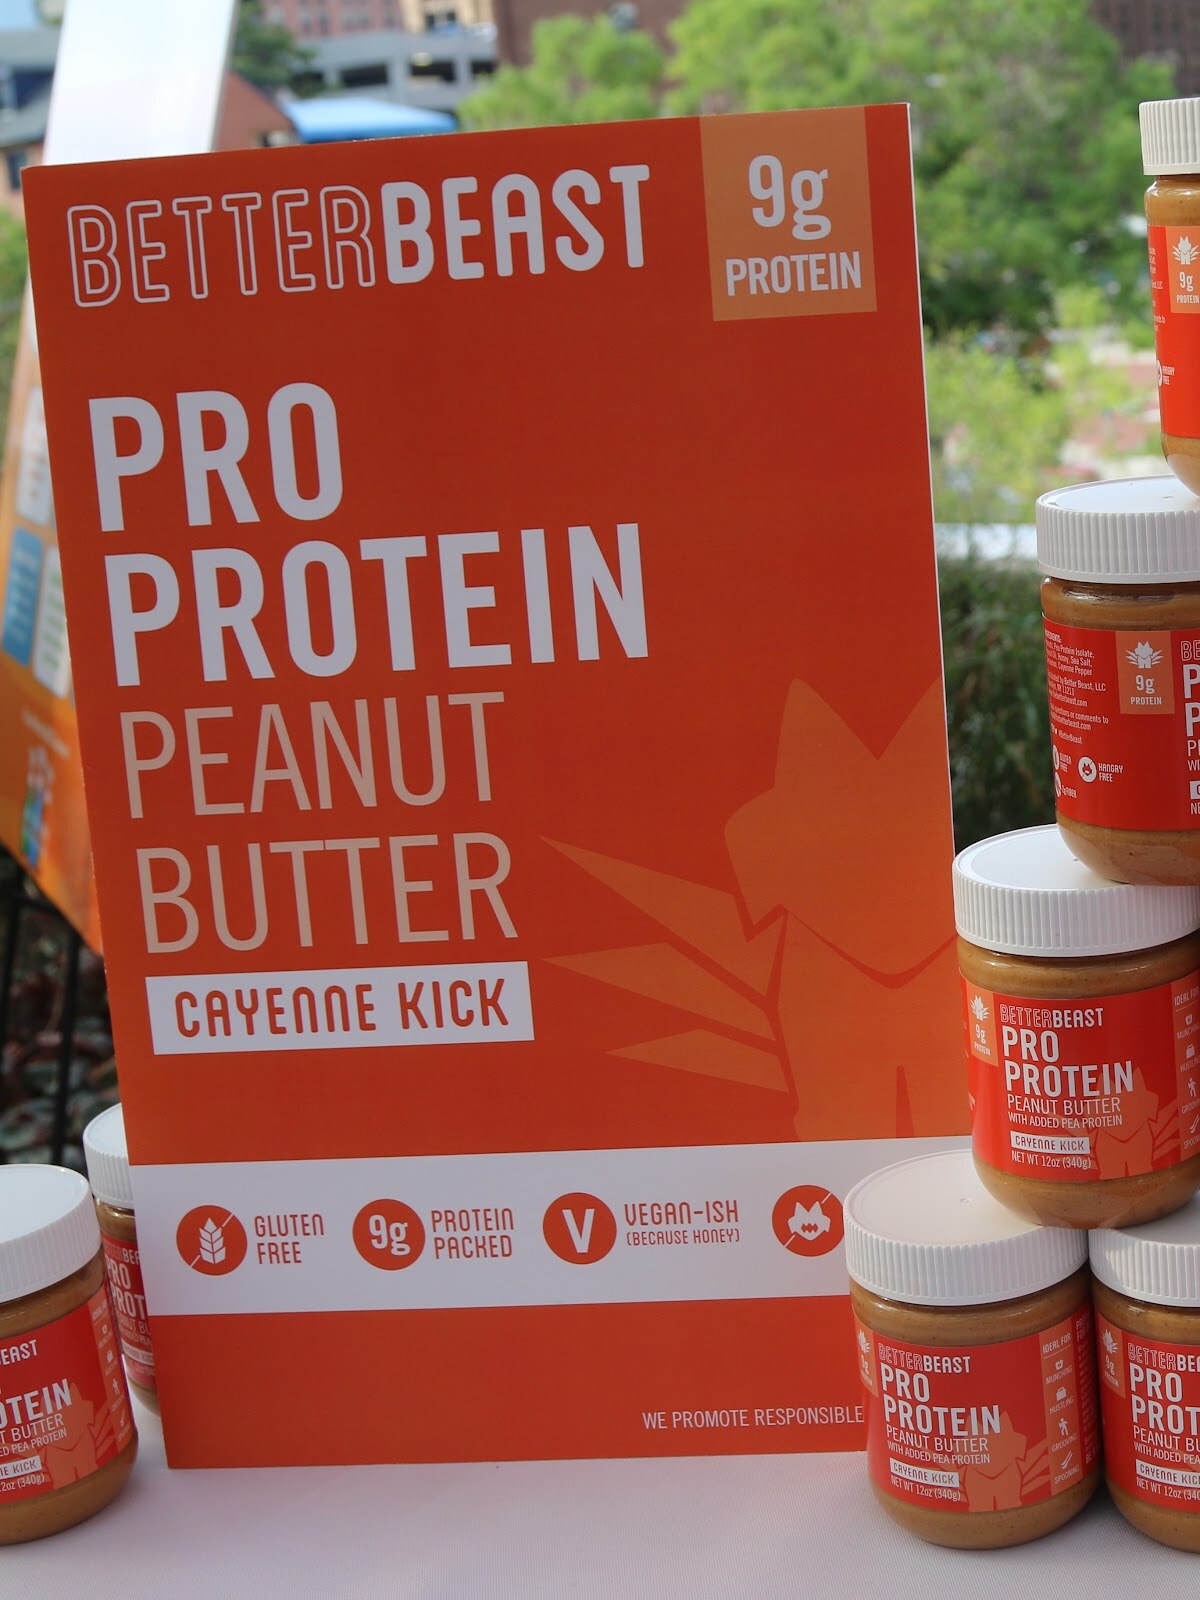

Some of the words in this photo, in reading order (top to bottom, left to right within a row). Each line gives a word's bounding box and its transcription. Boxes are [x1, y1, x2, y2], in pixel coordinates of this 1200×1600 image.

[748, 154, 830, 241] 9g
[67, 165, 650, 307] BETTERBEAST
[724, 250, 862, 297] PROTEIN
[1180, 272, 1193, 292] 9g
[1177, 294, 1199, 304] PROTEIN
[88, 382, 344, 532] PRO
[104, 522, 648, 687] PROTEIN
[1136, 675, 1154, 693] 9g
[1130, 696, 1161, 705] PROTEIN
[120, 692, 505, 818] PEANUT
[1099, 764, 1123, 773] HANGRY
[1099, 773, 1113, 782] FREE
[136, 832, 518, 954] BUTTER
[175, 982, 375, 1039] CAYENNE
[399, 978, 508, 1028] KICK
[1000, 1003, 1103, 1028] BETTERBEAST
[1002, 1025, 1059, 1062] PRO
[1004, 1060, 1133, 1097] PROTEIN
[1008, 1094, 1057, 1114] PEANUT
[1064, 1098, 1120, 1115] BUTTER
[1008, 1112, 1027, 1125] WITH
[1029, 1115, 1059, 1128] ADDED
[1062, 1117, 1080, 1128] PEA
[1083, 1115, 1122, 1128] PROTEIN
[1016, 1135, 1055, 1150] CAYENNE
[1060, 1140, 1084, 1150] KICK
[254, 1213, 326, 1239] GLUTEN
[430, 1207, 515, 1233] PROTEIN
[624, 1200, 740, 1227] VEGAN-ISH
[369, 1213, 408, 1257] 9g
[434, 1234, 513, 1260] PACKED
[626, 1227, 688, 1248] (BECAUSE
[693, 1225, 740, 1246] HONEY)
[257, 1241, 302, 1265] FREE
[878, 1343, 970, 1373] BETTERBEAST
[880, 1362, 929, 1402] PRO
[1130, 1362, 1182, 1402] PRO
[642, 1411, 667, 1429] WE
[671, 1407, 750, 1428] PROMOTE
[754, 1403, 863, 1426] RESPONSIBLE
[883, 1393, 1000, 1436] PROTEIN
[12, 1414, 64, 1442] BUTTER
[12, 1442, 29, 1453] PEA
[31, 1428, 67, 1447] PROTEIN
[886, 1424, 929, 1449] PEANUT
[935, 1437, 988, 1452] BUTTER
[1133, 1426, 1180, 1450] PEANUT
[1134, 1441, 1151, 1456] WITH
[1154, 1447, 1180, 1462] ADDED
[1183, 1453, 1200, 1464] PEA
[12, 1460, 36, 1473] KICK
[894, 1462, 928, 1481] CAYENNE
[932, 1472, 954, 1484] KICK
[1140, 1464, 1177, 1482] CAYENNE
